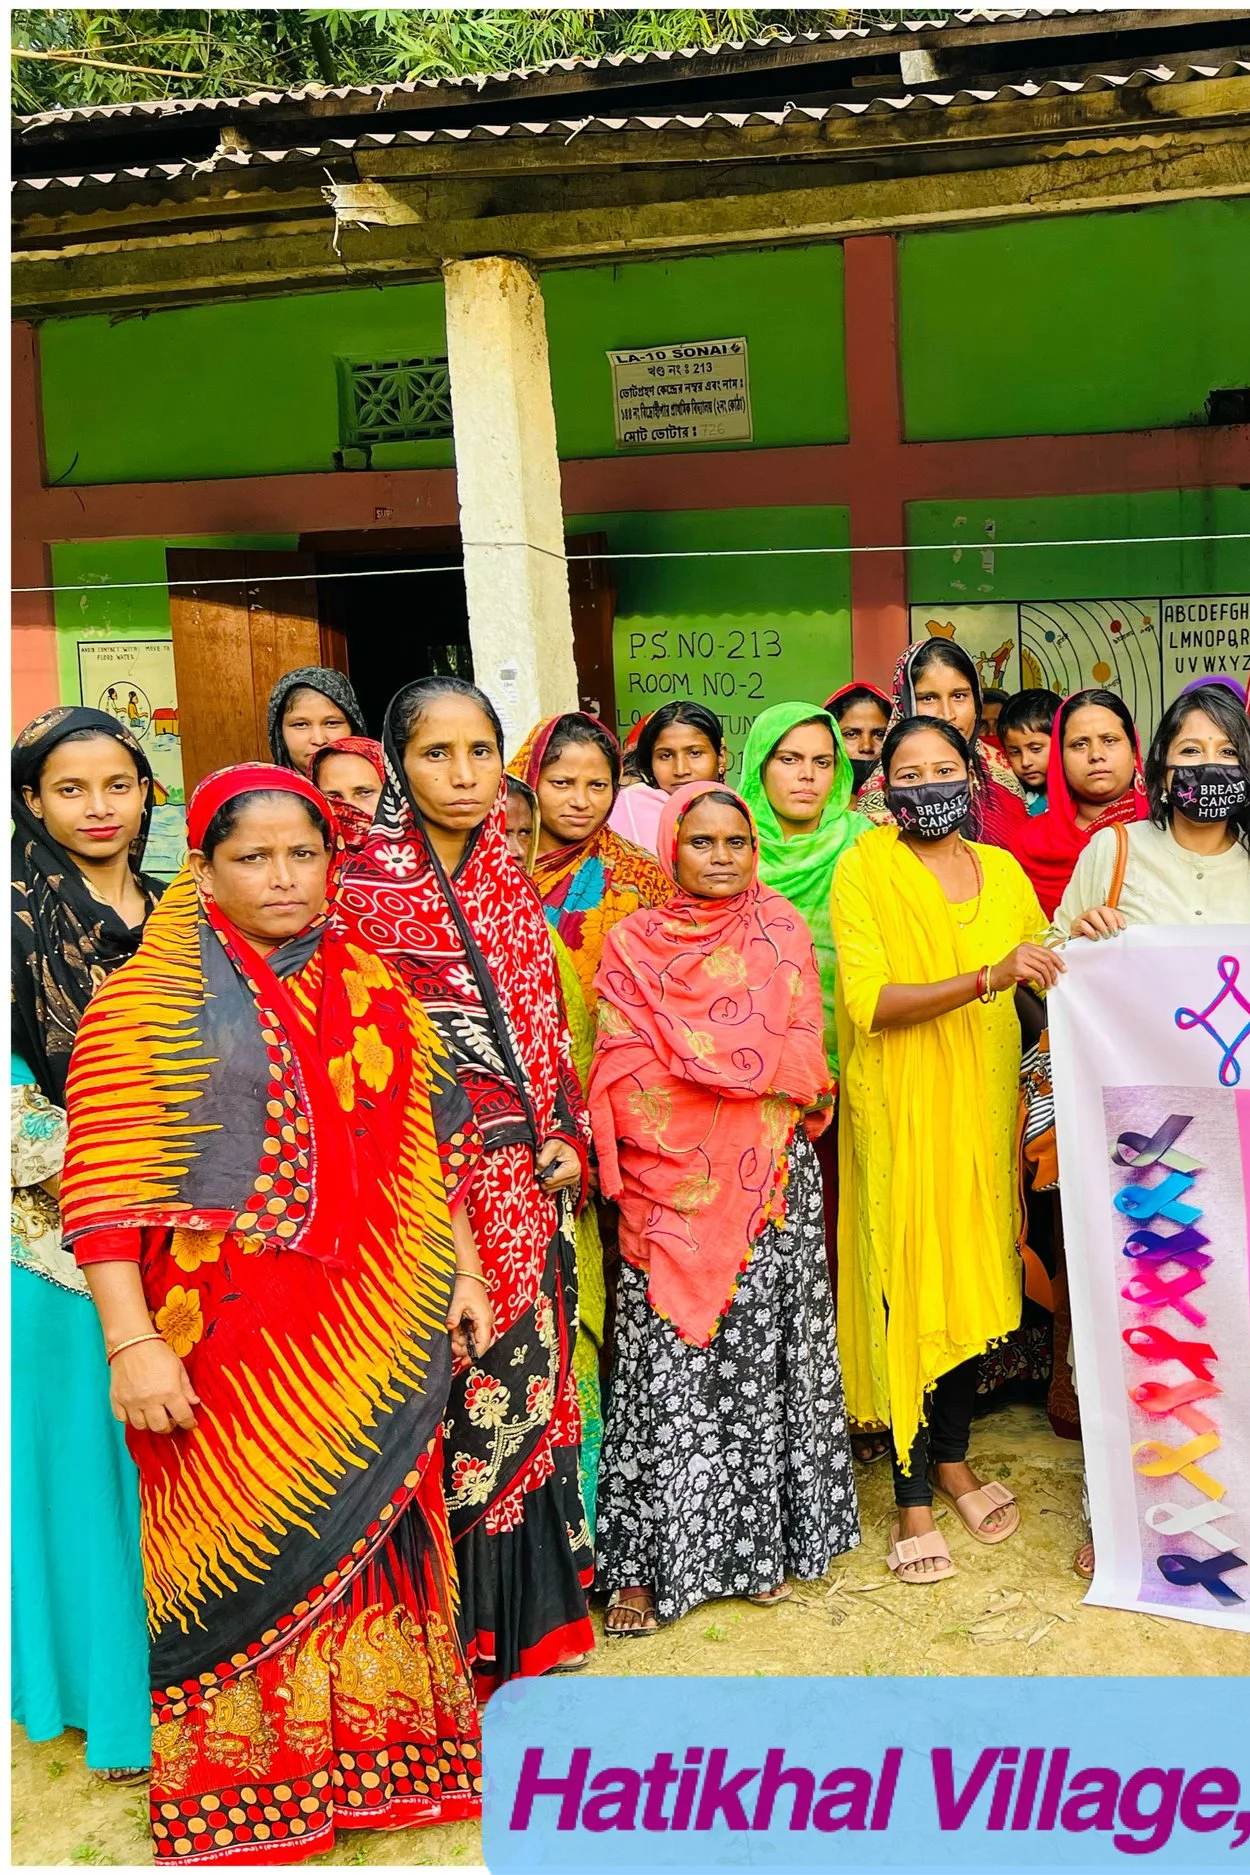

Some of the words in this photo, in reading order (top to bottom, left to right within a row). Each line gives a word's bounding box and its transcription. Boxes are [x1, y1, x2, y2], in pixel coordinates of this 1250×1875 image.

[616, 351, 667, 363] LA-10
[672, 344, 727, 358] SONAI
[694, 361, 713, 373] 213
[624, 426, 649, 442] মোট
[652, 423, 689, 441] ভোটার
[628, 672, 693, 696] ROOM
[1200, 780, 1245, 796] BREAST
[916, 795, 962, 816] BREAST
